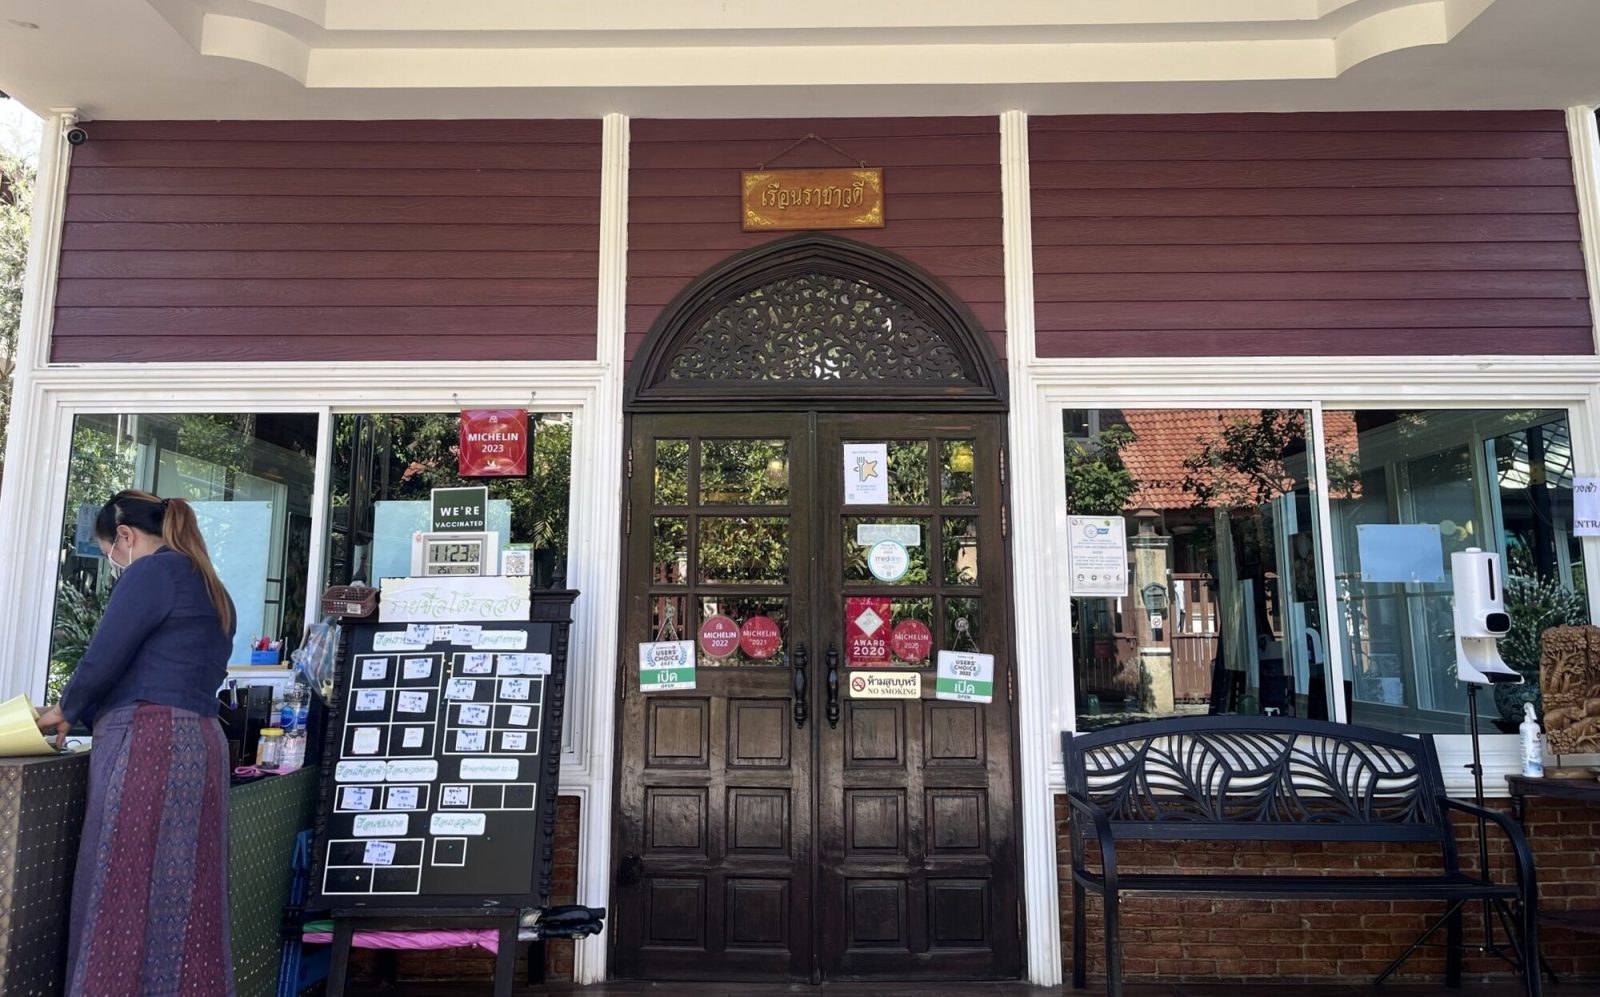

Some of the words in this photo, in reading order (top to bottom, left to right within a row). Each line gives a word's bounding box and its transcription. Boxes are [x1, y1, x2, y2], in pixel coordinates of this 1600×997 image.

[761, 181, 864, 209] เรือนราชาวดี
[468, 432, 518, 441] MICHELIN
[481, 444, 504, 453] 2023
[440, 506, 480, 516] WE'RE
[854, 647, 885, 656] 2020
[657, 670, 678, 683] เปิด
[954, 680, 975, 694] เปิด
